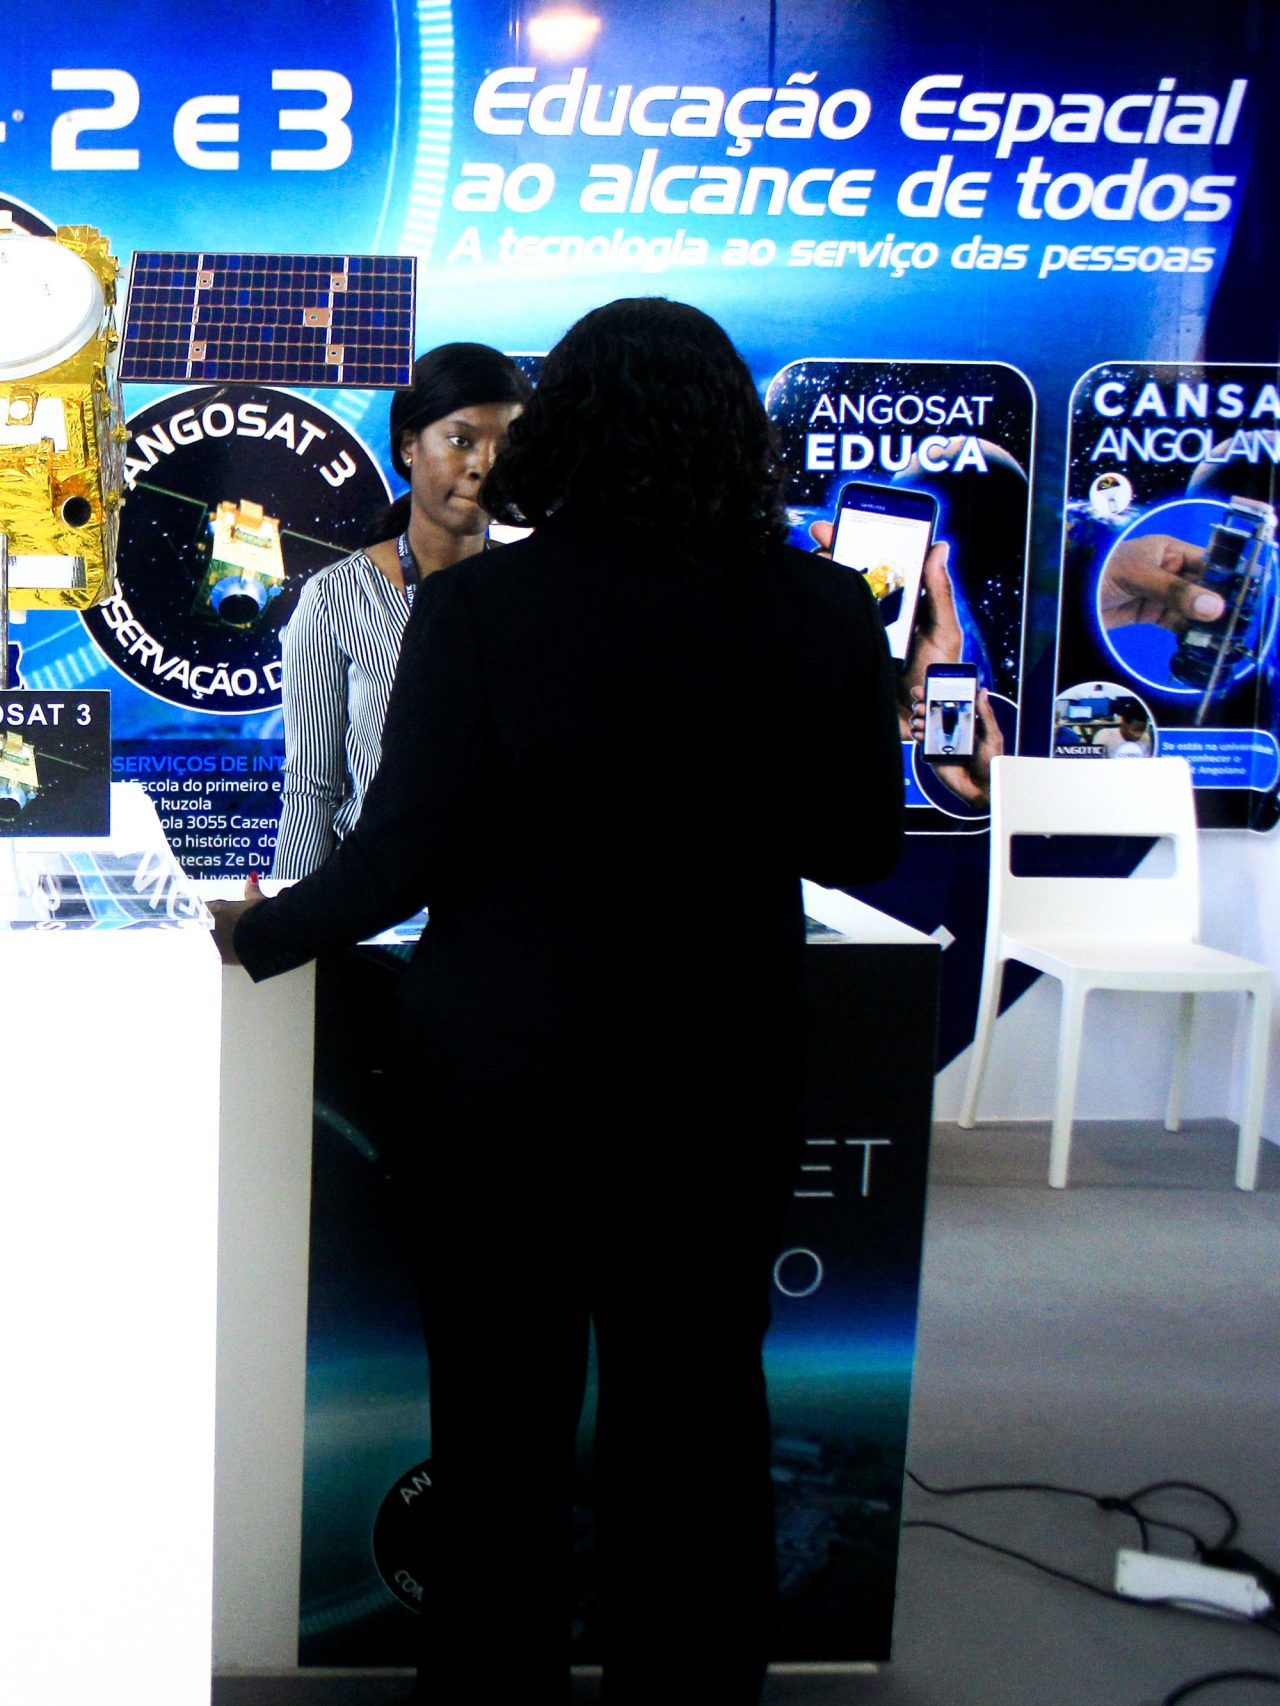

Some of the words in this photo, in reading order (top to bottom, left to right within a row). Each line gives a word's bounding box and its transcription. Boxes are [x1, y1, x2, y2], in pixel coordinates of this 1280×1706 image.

[51, 69, 141, 171] 2
[270, 69, 354, 172] 3
[472, 67, 872, 156] Educação
[900, 77, 1249, 159] Espacial
[452, 162, 556, 214] ao
[586, 151, 873, 218] alcance
[897, 154, 992, 218] de
[1016, 156, 1238, 222] todos
[448, 228, 484, 263] A
[499, 227, 708, 274] tecnologia
[720, 235, 777, 266] ao
[788, 233, 943, 279] serviço
[950, 235, 1027, 270] das
[1037, 245, 1215, 279] pessoas
[809, 393, 993, 427] ANGOSAT
[1093, 382, 1280, 419] CANSA
[122, 403, 327, 490] ANGOSAT
[320, 450, 358, 488] 3
[805, 434, 990, 473] EDUCA
[1090, 428, 1280, 465] ANGOLAN
[101, 578, 257, 700] SERVAÇÃO
[77, 703, 92, 726] 3
[112, 755, 216, 776] SERVIÇOS
[221, 755, 248, 773] DE
[253, 755, 286, 773] INT
[182, 779, 203, 792] do
[206, 779, 269, 794] primeiro
[272, 782, 282, 792] e
[185, 834, 250, 848] histórico
[187, 815, 227, 830] 3055
[230, 815, 281, 829] Cazen
[225, 853, 245, 867] Ze
